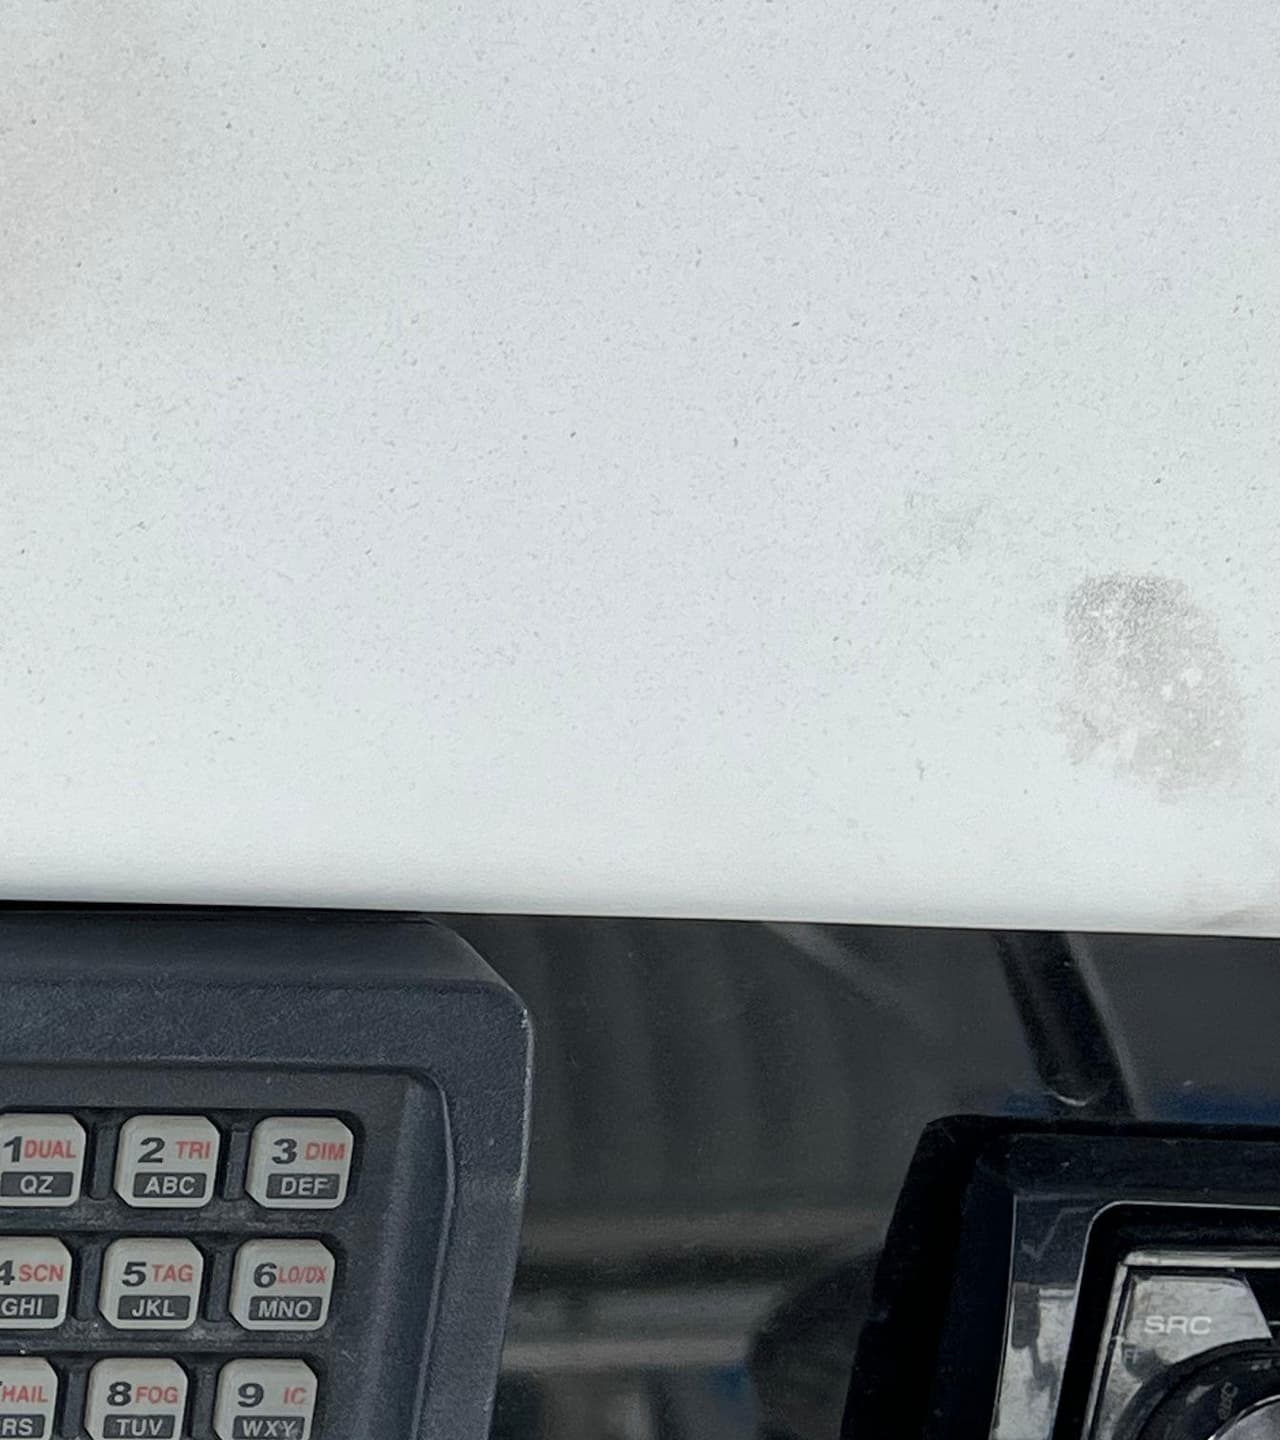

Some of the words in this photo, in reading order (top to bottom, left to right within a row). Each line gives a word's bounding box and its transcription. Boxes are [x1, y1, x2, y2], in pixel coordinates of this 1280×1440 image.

[2, 1135, 23, 1163] 1
[24, 1139, 77, 1159] DUAL
[137, 1136, 166, 1164] 2
[175, 1140, 212, 1159] TRI
[271, 1137, 298, 1165] 3
[304, 1142, 346, 1162] DIM
[19, 1175, 54, 1195] QZ
[143, 1175, 195, 1195] ABC
[279, 1177, 330, 1196] DEF
[17, 1264, 65, 1283] SCN
[121, 1260, 148, 1287] 5
[151, 1264, 194, 1283] TAG
[253, 1262, 278, 1289] 6
[0, 1297, 43, 1317] GHI
[131, 1298, 176, 1318] JKL
[257, 1299, 313, 1319] MNO
[1143, 1315, 1212, 1335] SRC
[2, 1384, 49, 1404] HAIL
[106, 1380, 132, 1407] 8
[134, 1385, 179, 1405] FOG
[236, 1381, 264, 1408] 9
[283, 1387, 306, 1406] IC
[116, 1418, 163, 1437] TUV
[242, 1419, 297, 1438] WXY
